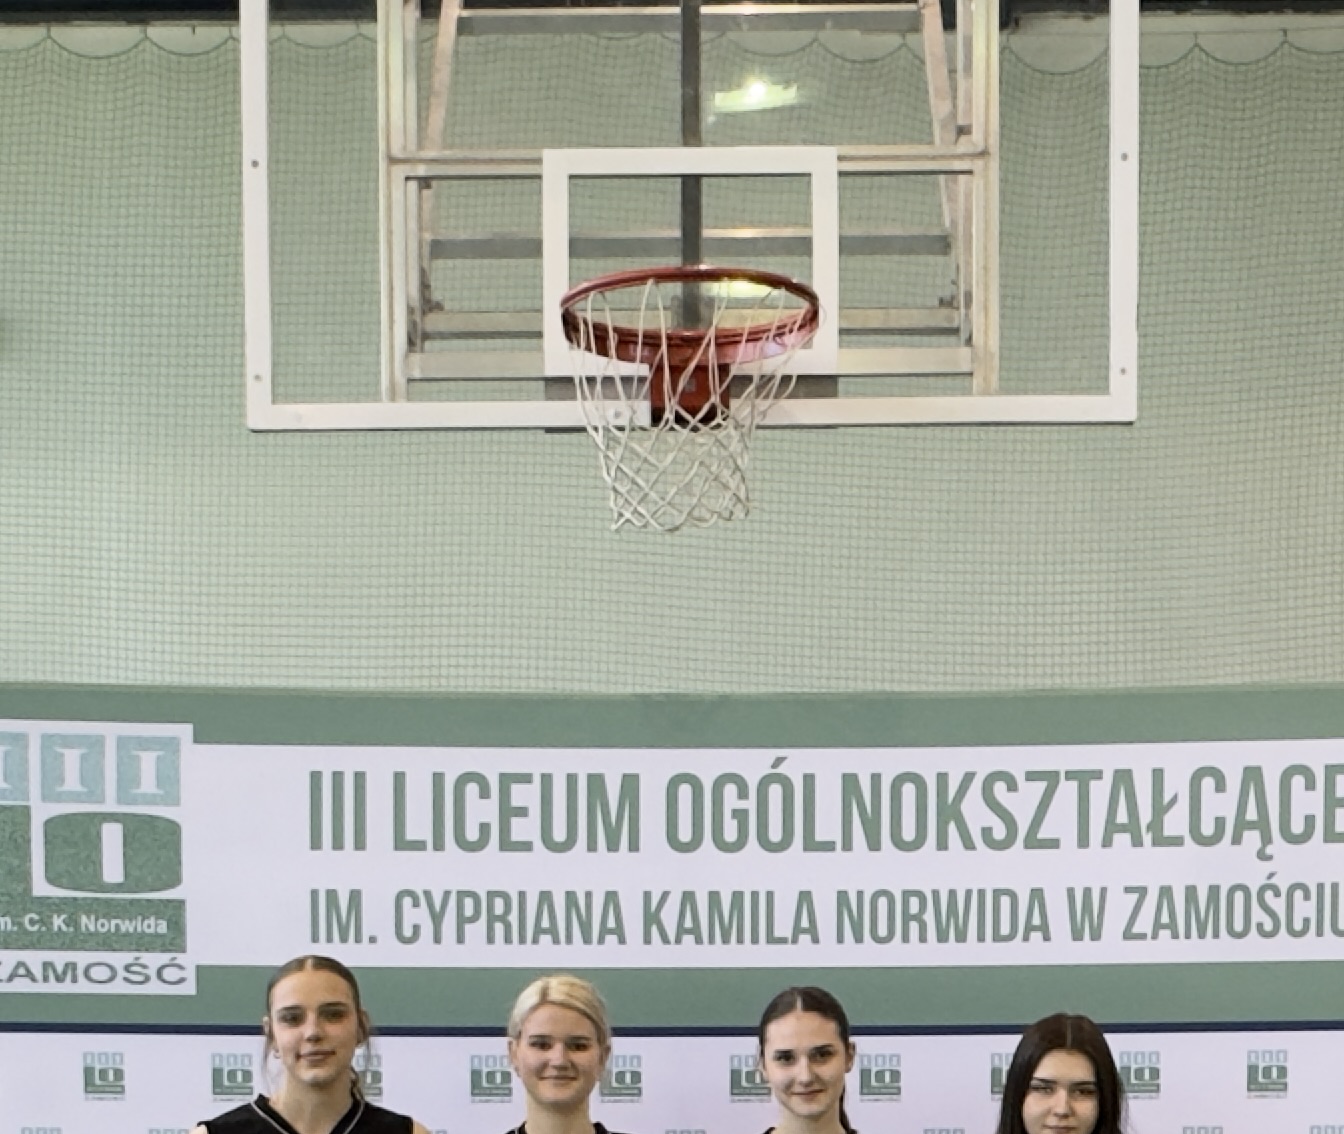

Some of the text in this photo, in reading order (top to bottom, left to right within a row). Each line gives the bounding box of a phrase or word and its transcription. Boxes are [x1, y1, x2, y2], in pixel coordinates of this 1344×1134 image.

[309, 770, 368, 852] III
[393, 770, 640, 854] LICEUM
[24, 912, 47, 932] C.
[52, 913, 74, 932] K.
[80, 914, 169, 934] Norwida
[309, 888, 378, 944] IM.
[394, 888, 627, 945] CYPRIANA
[643, 889, 820, 946] KAMILA
[836, 887, 1052, 945] NORWIDA
[1067, 886, 1108, 942] W
